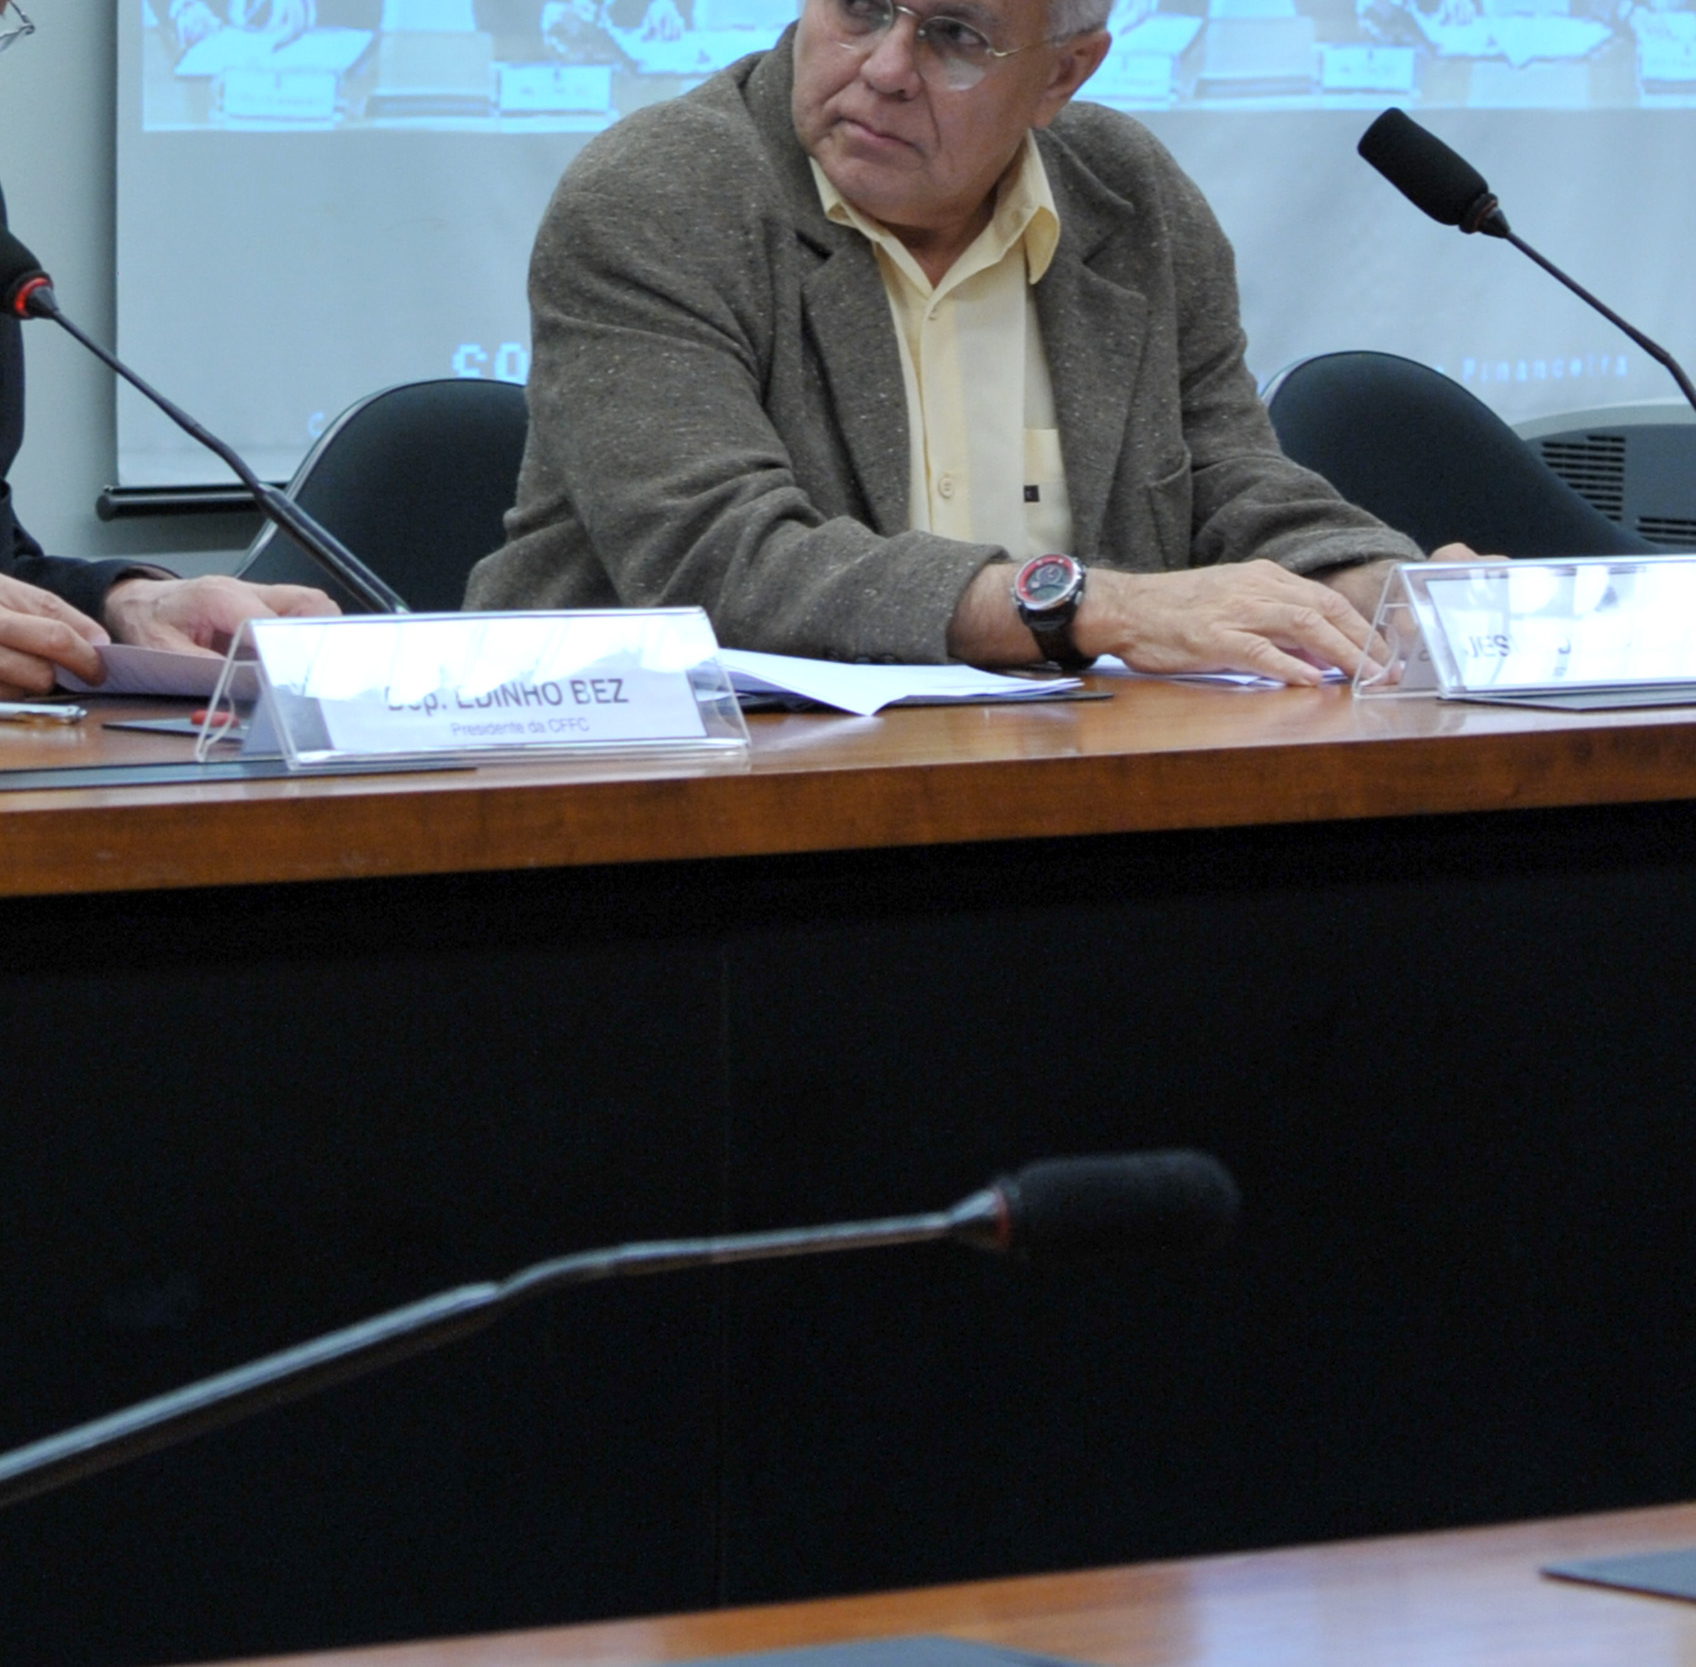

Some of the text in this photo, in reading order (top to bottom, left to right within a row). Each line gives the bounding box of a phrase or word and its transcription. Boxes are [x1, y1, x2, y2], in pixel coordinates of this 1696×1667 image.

[569, 678, 629, 704] BEZ
[450, 717, 590, 736] Presidente da CFFC
